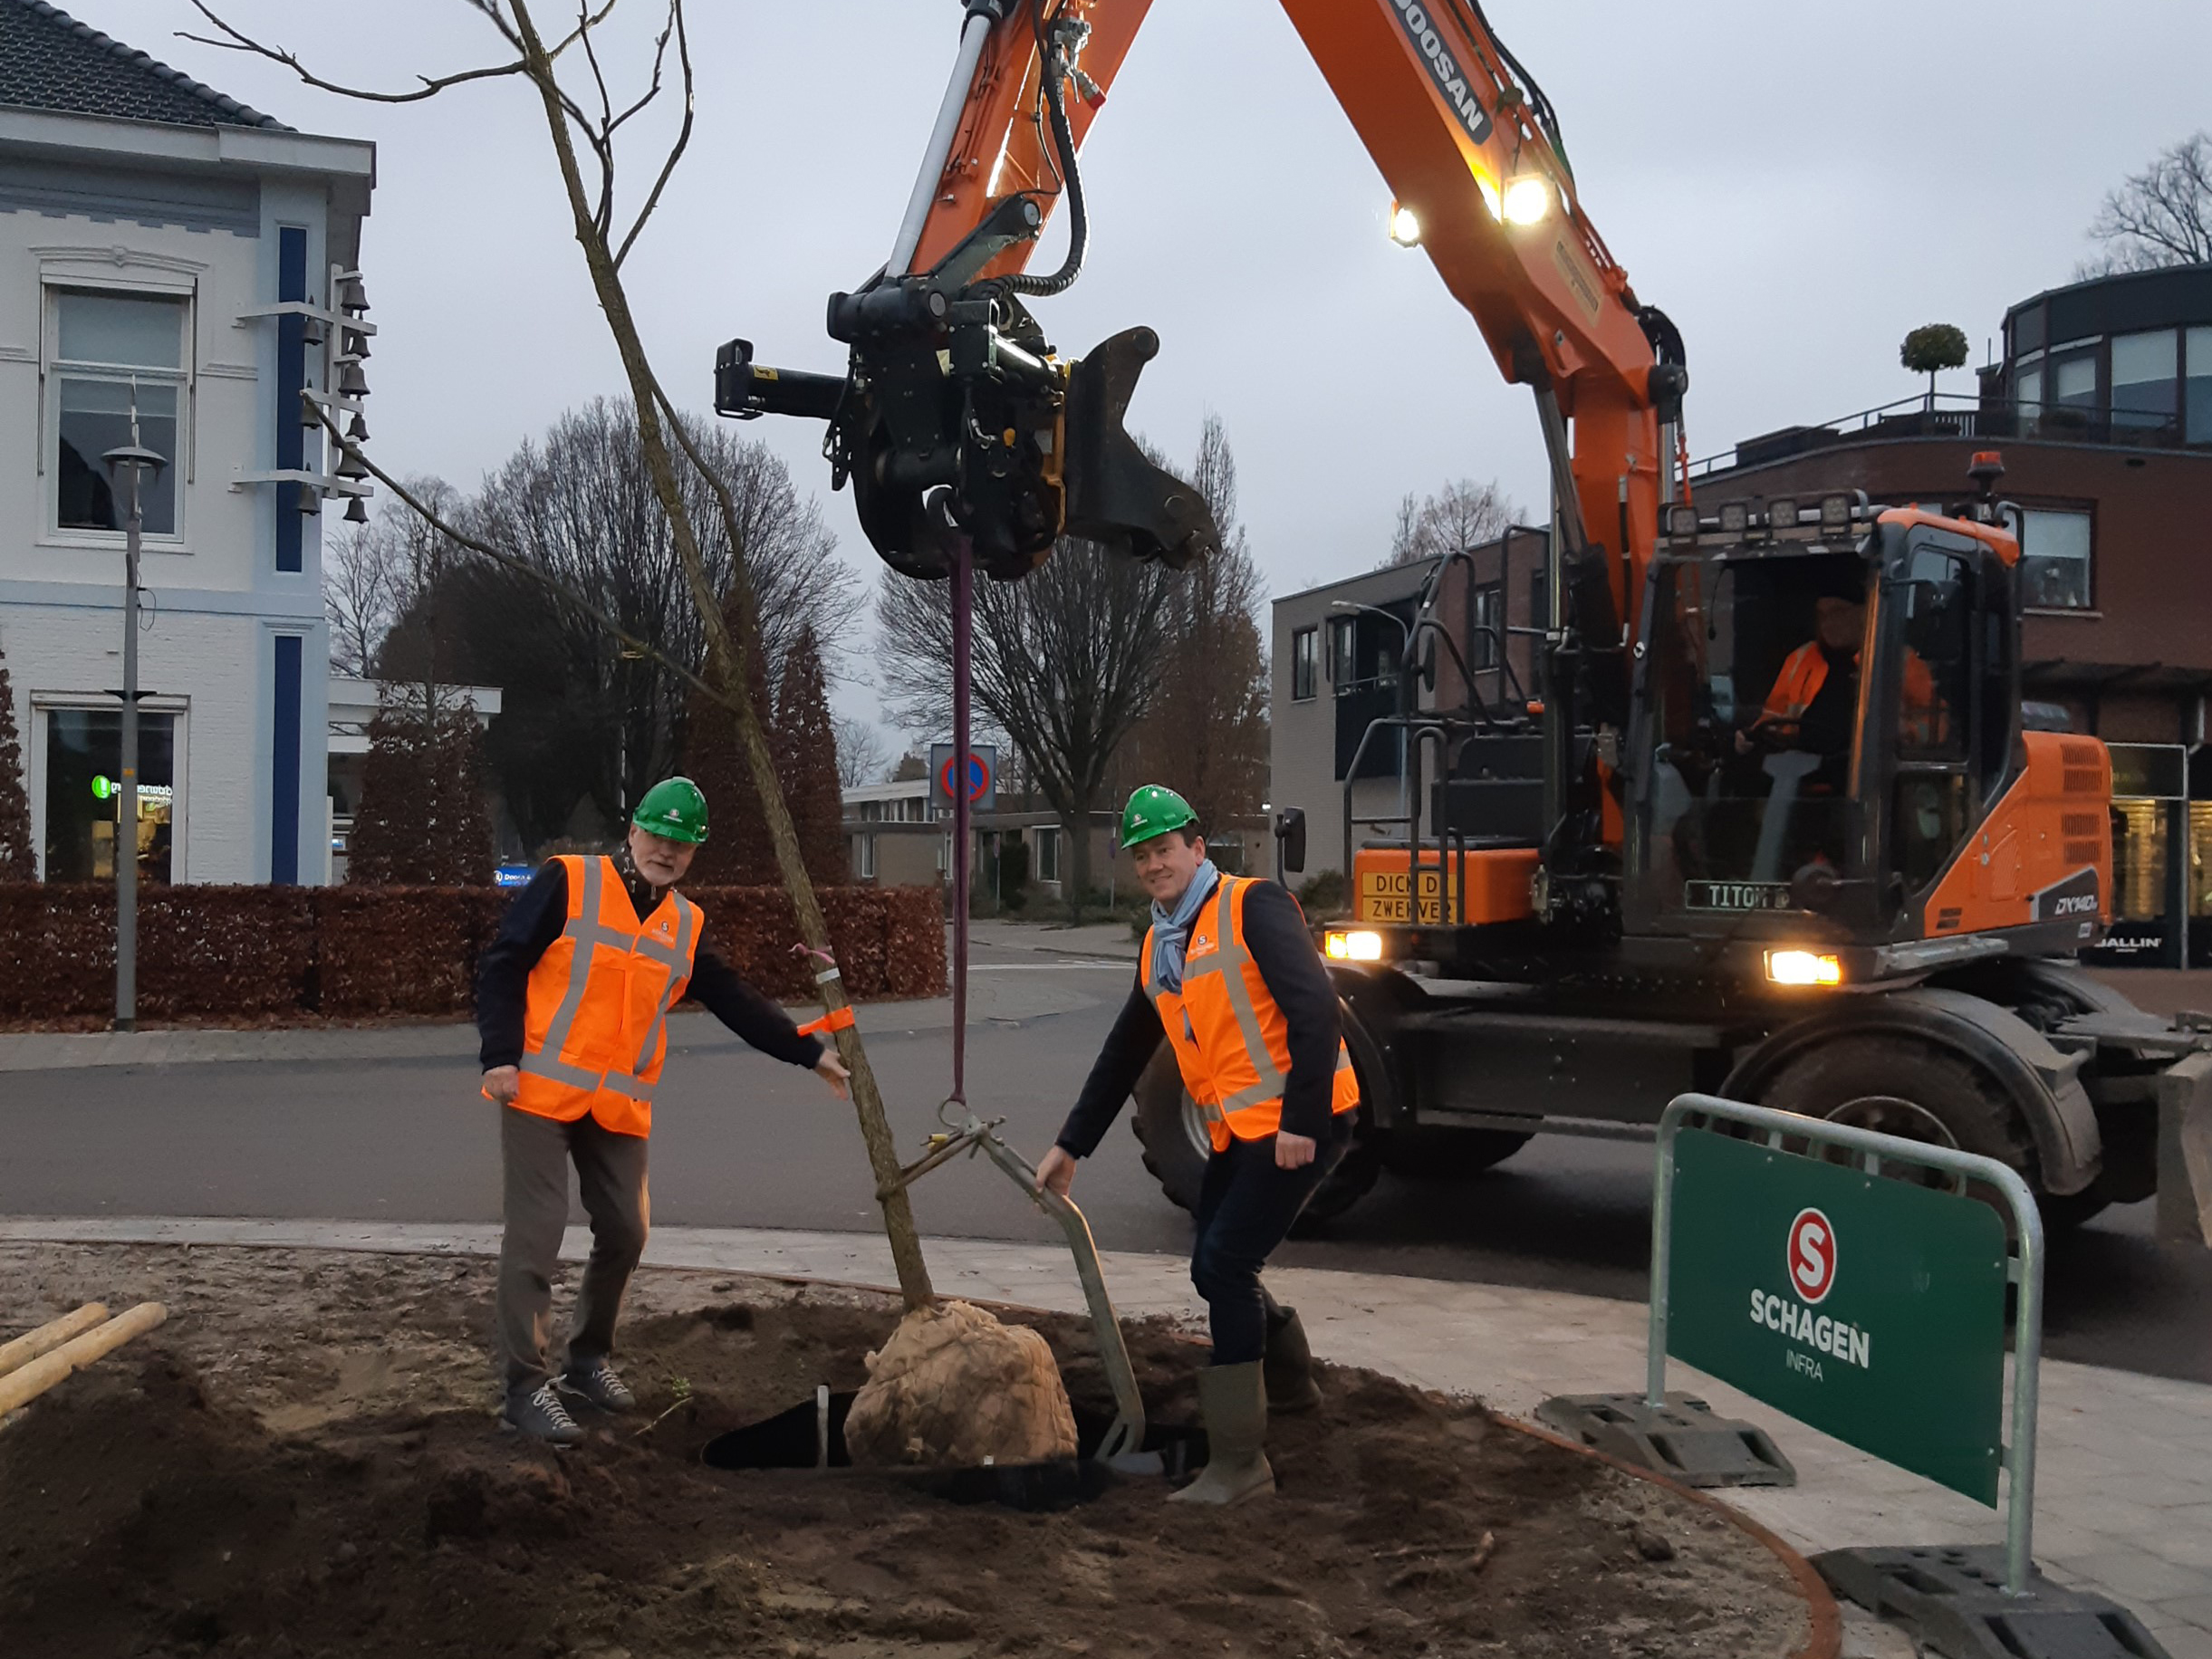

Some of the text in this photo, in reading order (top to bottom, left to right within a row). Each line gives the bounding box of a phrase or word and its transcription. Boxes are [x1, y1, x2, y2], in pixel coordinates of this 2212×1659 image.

[1796, 1223, 1825, 1288] S
[1749, 1289, 1870, 1369] SCHAGEN
[1785, 1348, 1823, 1383] INFRA
